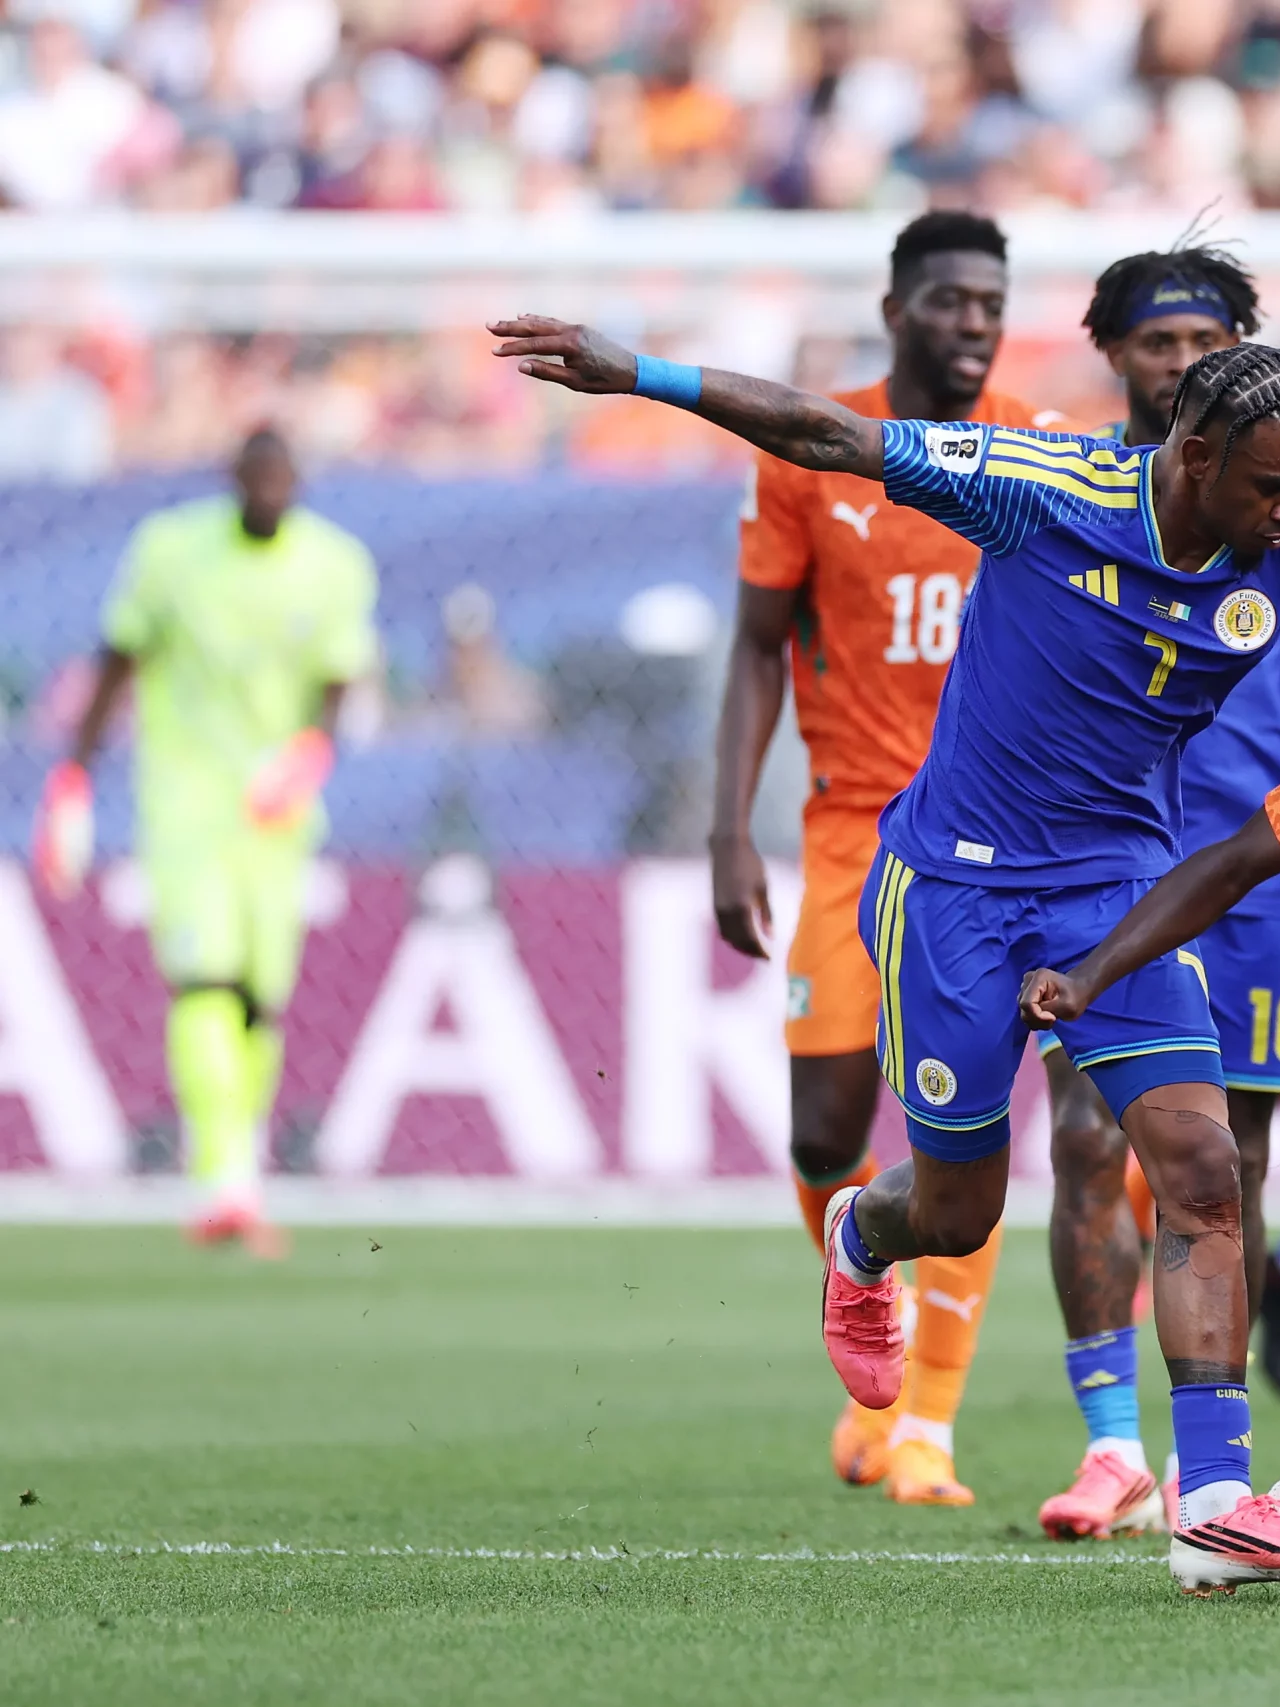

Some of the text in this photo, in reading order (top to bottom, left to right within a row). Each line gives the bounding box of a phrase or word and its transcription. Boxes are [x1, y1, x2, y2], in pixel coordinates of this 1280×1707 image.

[883, 573, 961, 664] 18
[1218, 596, 1238, 643] Federashon
[1144, 631, 1177, 696] 7
